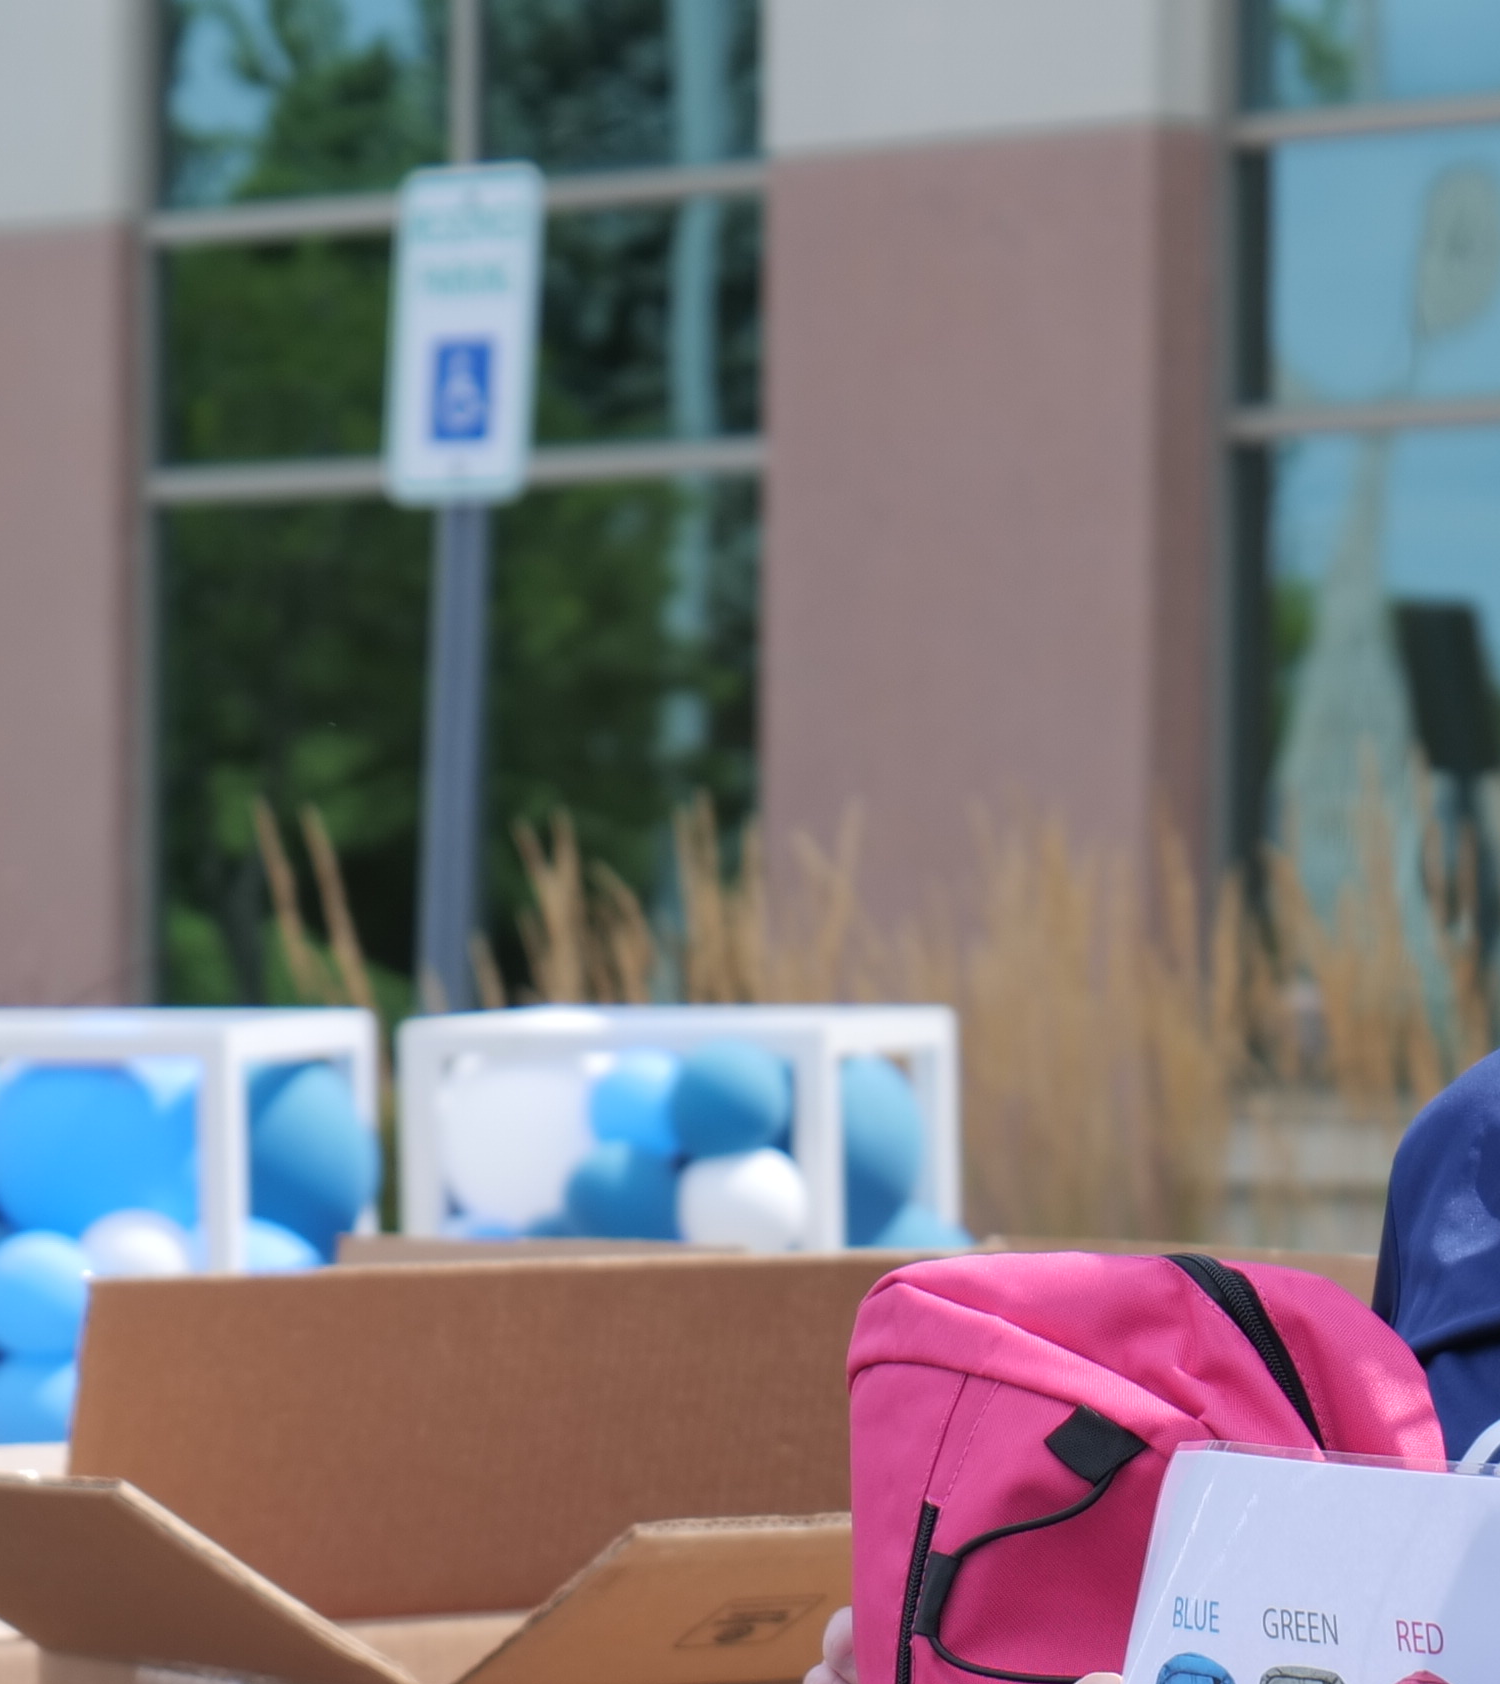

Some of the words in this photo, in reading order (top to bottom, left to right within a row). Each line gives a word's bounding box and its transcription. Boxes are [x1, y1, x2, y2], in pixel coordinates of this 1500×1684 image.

[1172, 1596, 1219, 1633] BLUE
[1262, 1608, 1339, 1645] GREEN
[1396, 1620, 1444, 1655] RED
